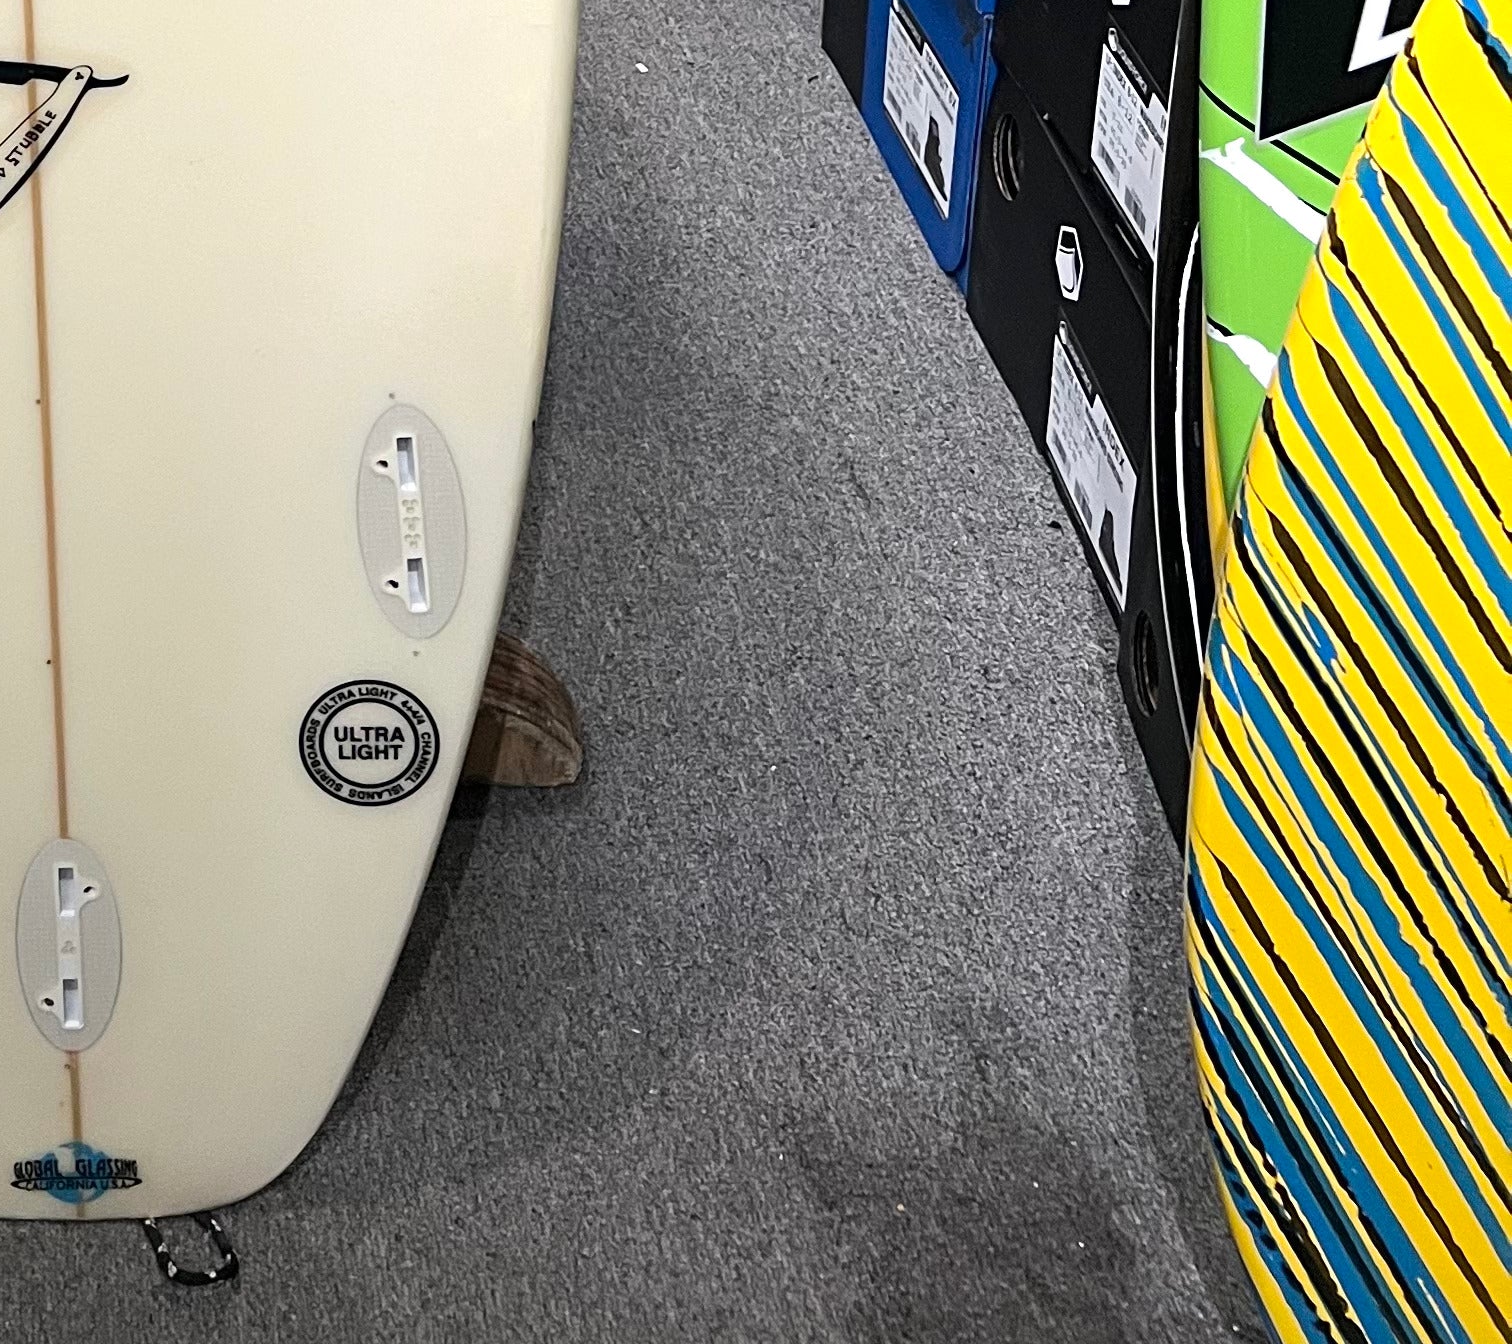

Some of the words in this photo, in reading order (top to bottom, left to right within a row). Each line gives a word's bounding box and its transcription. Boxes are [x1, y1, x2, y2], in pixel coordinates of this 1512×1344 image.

[4, 109, 57, 166] STUBBLE
[318, 689, 356, 715] ULTRA
[358, 686, 398, 701] LIGHT
[334, 726, 405, 743] ULTRA
[306, 718, 344, 793] SURFBOARDS
[338, 744, 403, 760] LIGHT
[404, 731, 432, 785] CHANNEL
[348, 783, 405, 800] ISLANDS
[13, 1160, 63, 1179] GLOBAL
[75, 1158, 138, 1178] GLASSING
[25, 1178, 97, 1192] CALIFORNIA
